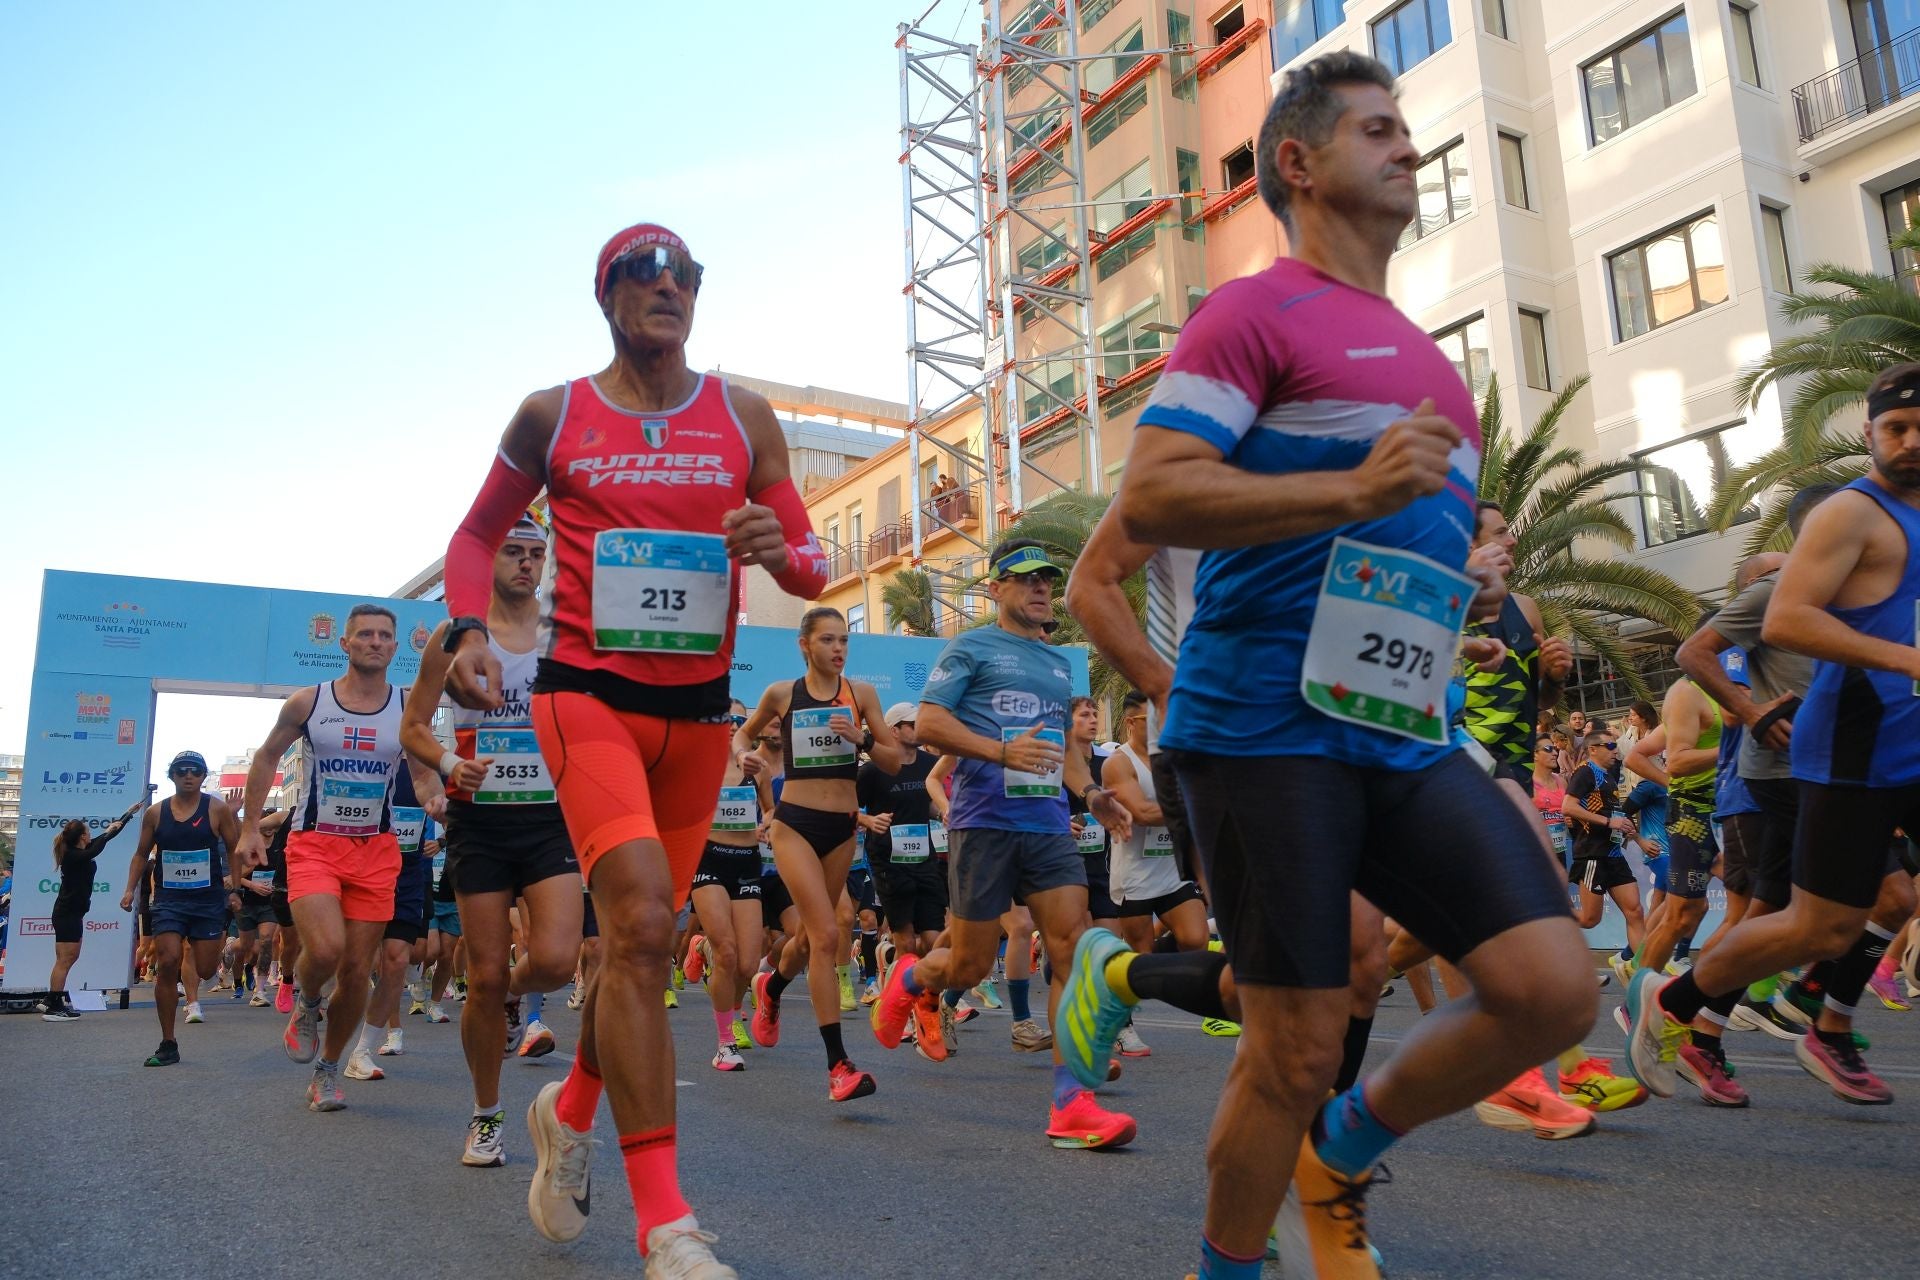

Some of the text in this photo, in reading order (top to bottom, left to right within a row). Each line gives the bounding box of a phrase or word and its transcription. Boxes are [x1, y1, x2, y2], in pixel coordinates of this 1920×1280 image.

[568, 453, 725, 476] RUNNER
[588, 470, 736, 489] VARESE
[641, 587, 687, 611] 213
[57, 613, 188, 629] AYUNTAMIENTO AJUNTAMENT
[95, 624, 151, 635] SANTA POLA
[293, 650, 349, 662] Ayuntamiento
[1356, 632, 1435, 680] 2978
[298, 659, 343, 669] de Alicante
[1000, 694, 1037, 714] Eter
[808, 735, 842, 748] 1684
[320, 759, 391, 776] NORWAY
[494, 765, 539, 779] 3633
[43, 770, 125, 786] LOPEZ
[41, 785, 123, 794] Asistencia
[334, 805, 370, 818] 3895
[721, 807, 746, 817] 1682
[712, 845, 735, 854] NIKE
[902, 842, 921, 850] 3192
[174, 868, 198, 877] 4114
[85, 920, 119, 931] Sport
